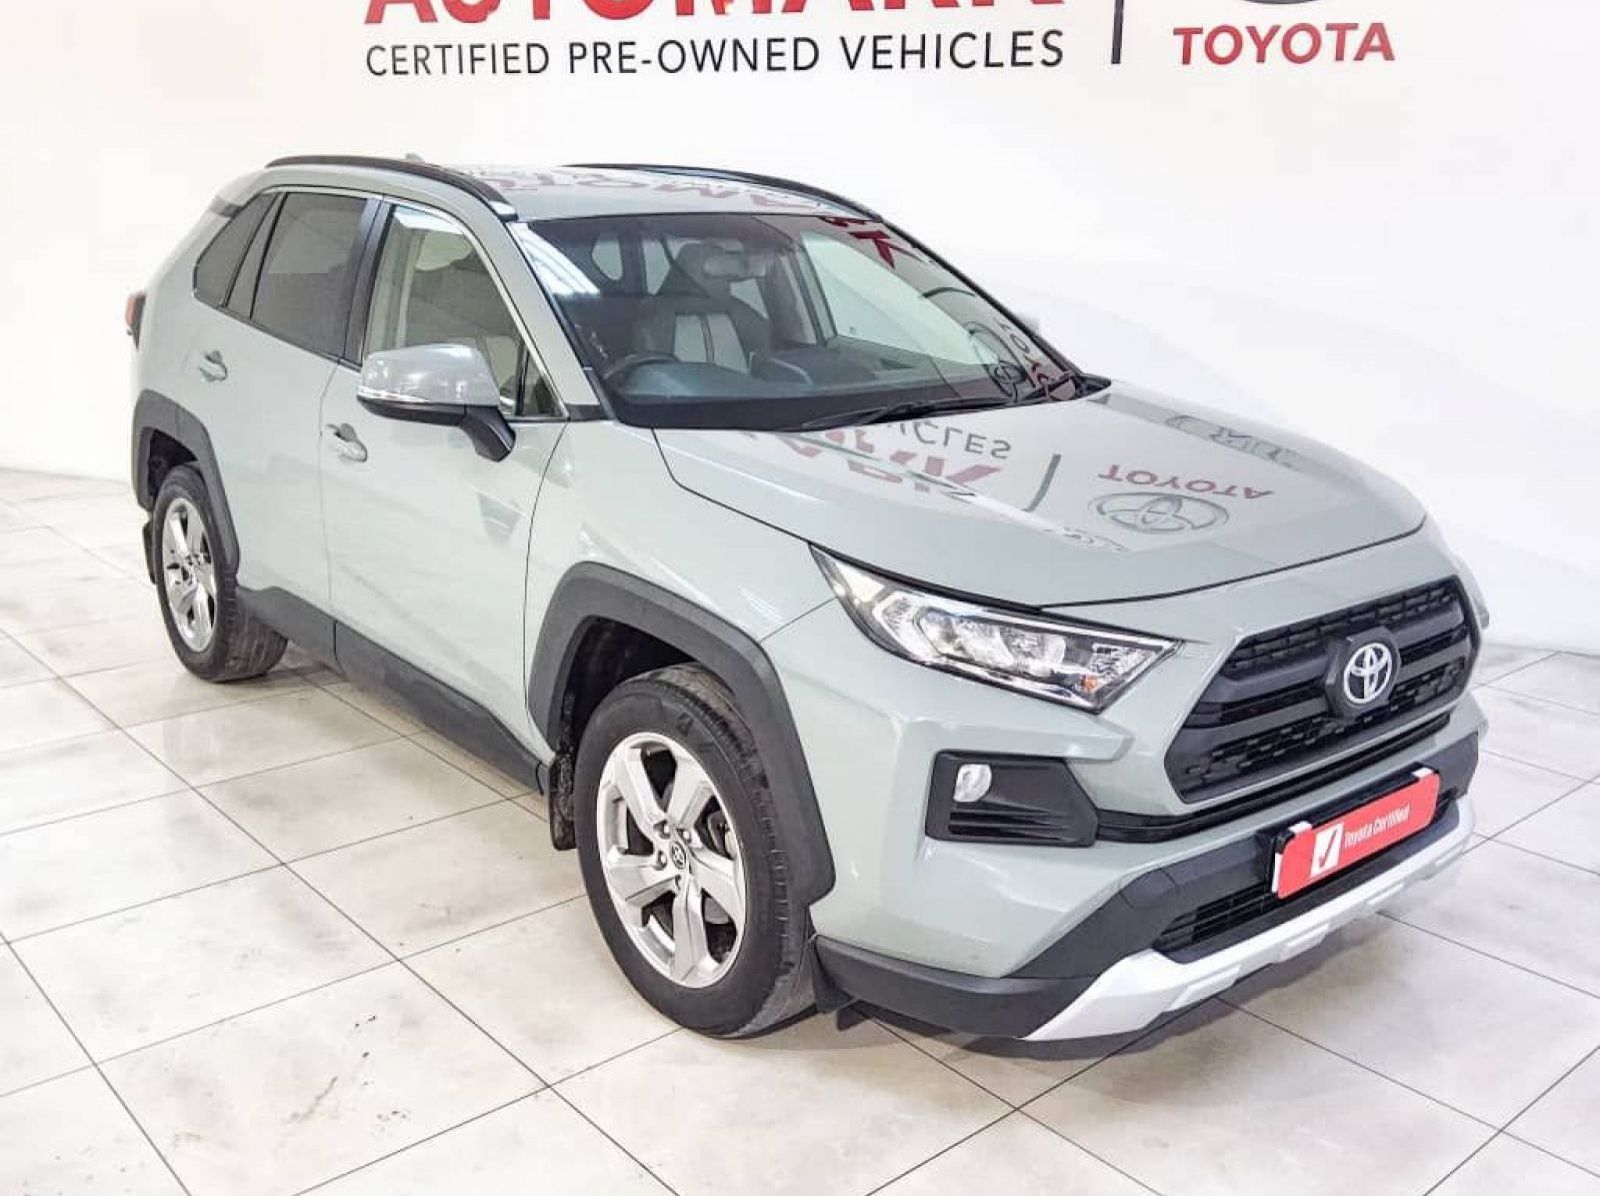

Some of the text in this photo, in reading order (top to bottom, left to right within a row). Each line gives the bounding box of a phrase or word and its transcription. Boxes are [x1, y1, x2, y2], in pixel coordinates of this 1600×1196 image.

[366, 29, 1064, 76] CERTIFIED PRE-OWNED VEHICLES
[1173, 22, 1396, 66] TOYOTA
[1344, 823, 1373, 849] Toyota
